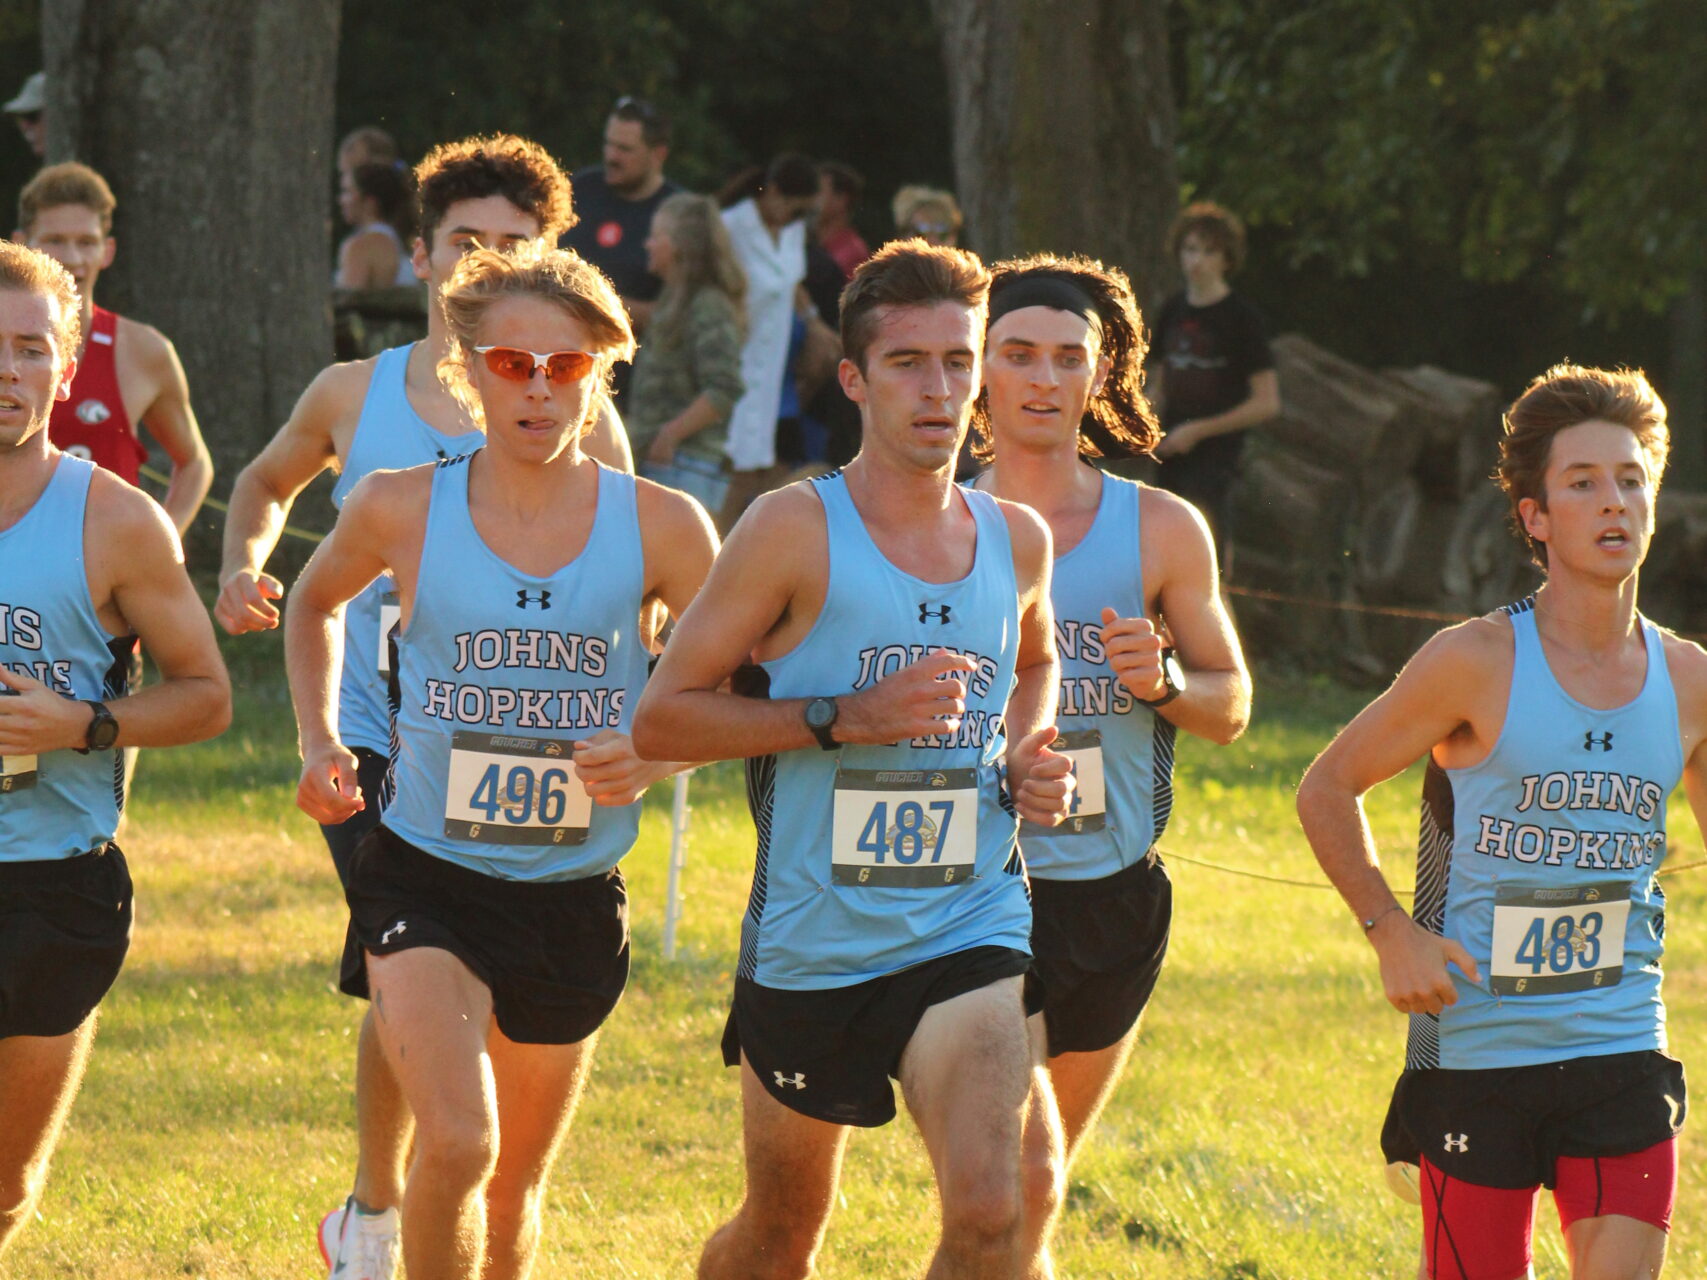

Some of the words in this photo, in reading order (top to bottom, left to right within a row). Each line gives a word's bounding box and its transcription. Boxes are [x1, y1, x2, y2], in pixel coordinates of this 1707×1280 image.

[453, 629, 608, 677] JOHNS
[424, 678, 626, 729] HOPKINS
[469, 763, 569, 825] 496
[1515, 771, 1663, 821] JOHNS
[857, 800, 954, 864] 487
[1475, 815, 1666, 869] HOPKINS
[1515, 911, 1603, 974] 483
